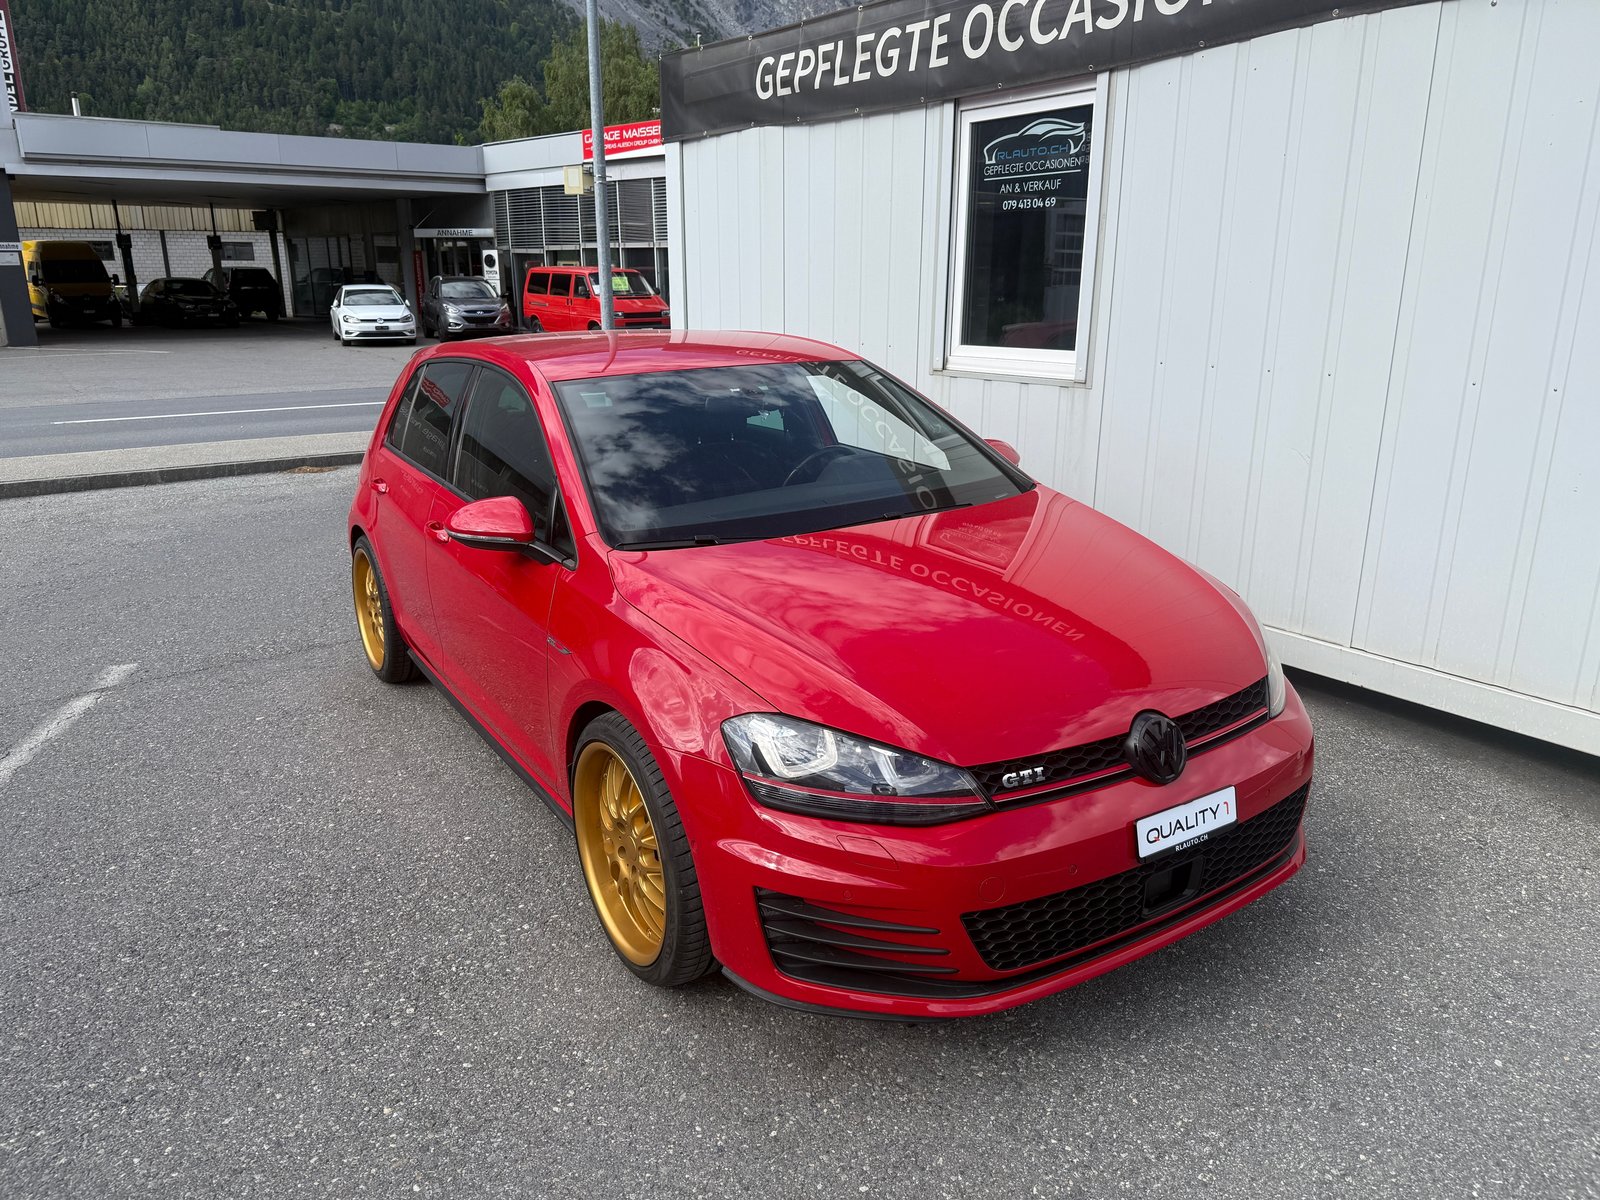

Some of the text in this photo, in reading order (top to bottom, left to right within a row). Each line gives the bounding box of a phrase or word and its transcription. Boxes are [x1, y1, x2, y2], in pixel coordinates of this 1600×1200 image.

[755, 0, 1212, 100] GEPFLEGTE OCCAS
[997, 143, 1069, 160] RLAUTO.CH
[983, 157, 1081, 176] GEPFLEGTE OCCASIONEN
[1000, 179, 1061, 194] AN & VERKAUF
[1002, 197, 1056, 210] 079 413 04 69
[1002, 766, 1046, 788] GTI
[1146, 801, 1230, 844] QUALITY 1
[1175, 833, 1209, 852] RLAUTO.CH
